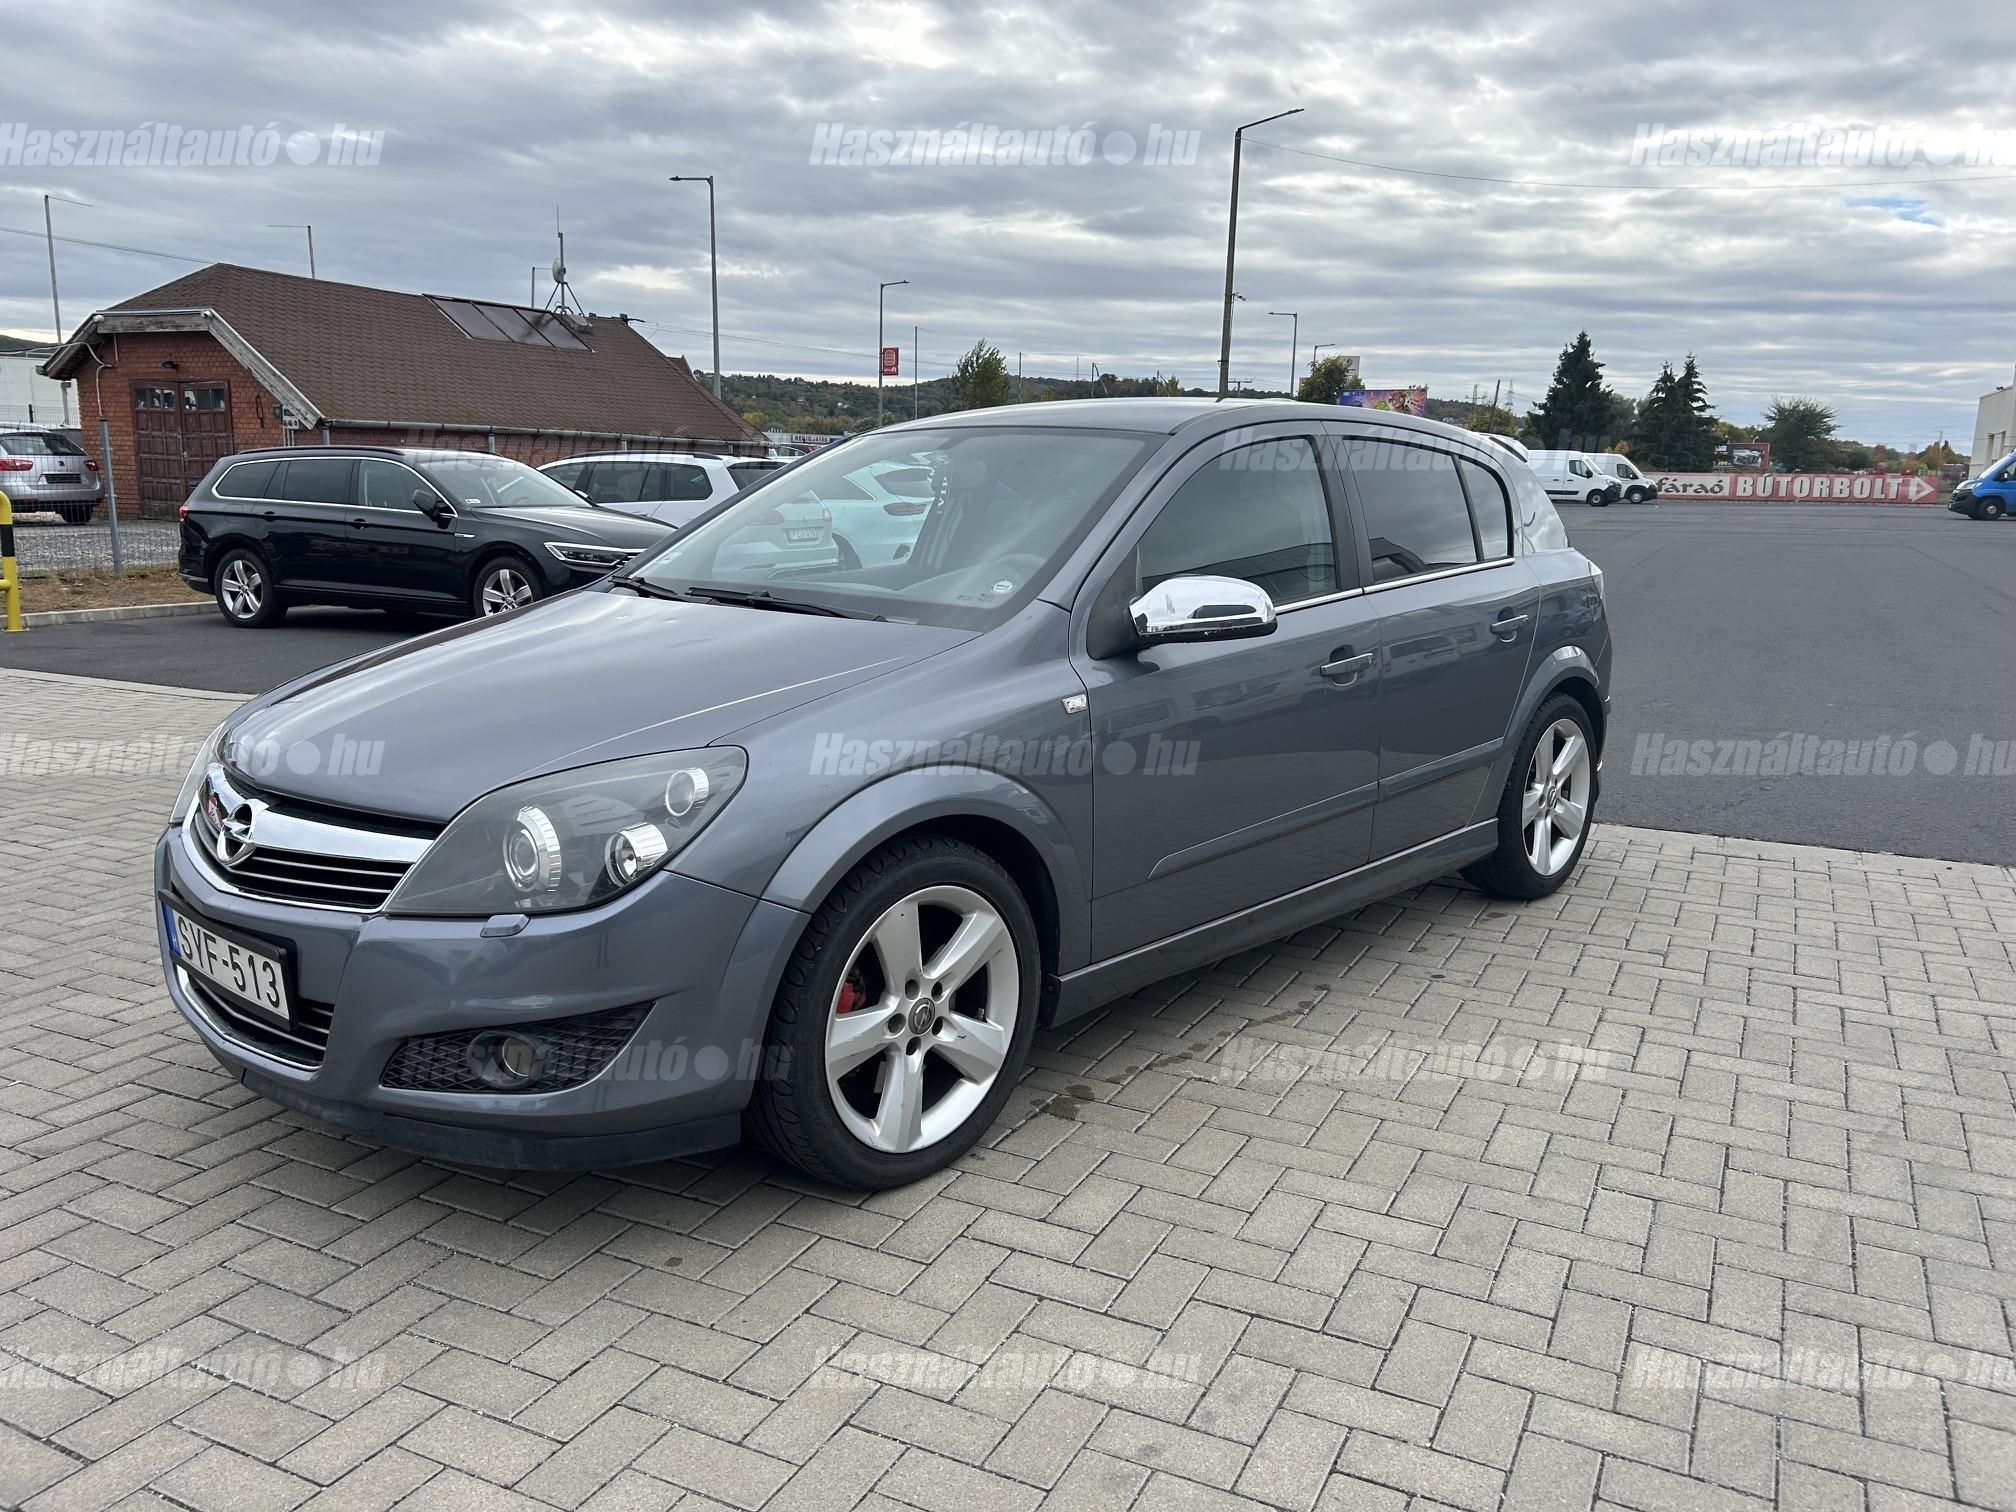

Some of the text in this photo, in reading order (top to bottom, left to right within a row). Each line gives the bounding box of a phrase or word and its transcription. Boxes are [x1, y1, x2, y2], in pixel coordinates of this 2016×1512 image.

[1657, 473, 1903, 500] fáraó BÚTORBOLT
[177, 915, 280, 1009] SYF-513
